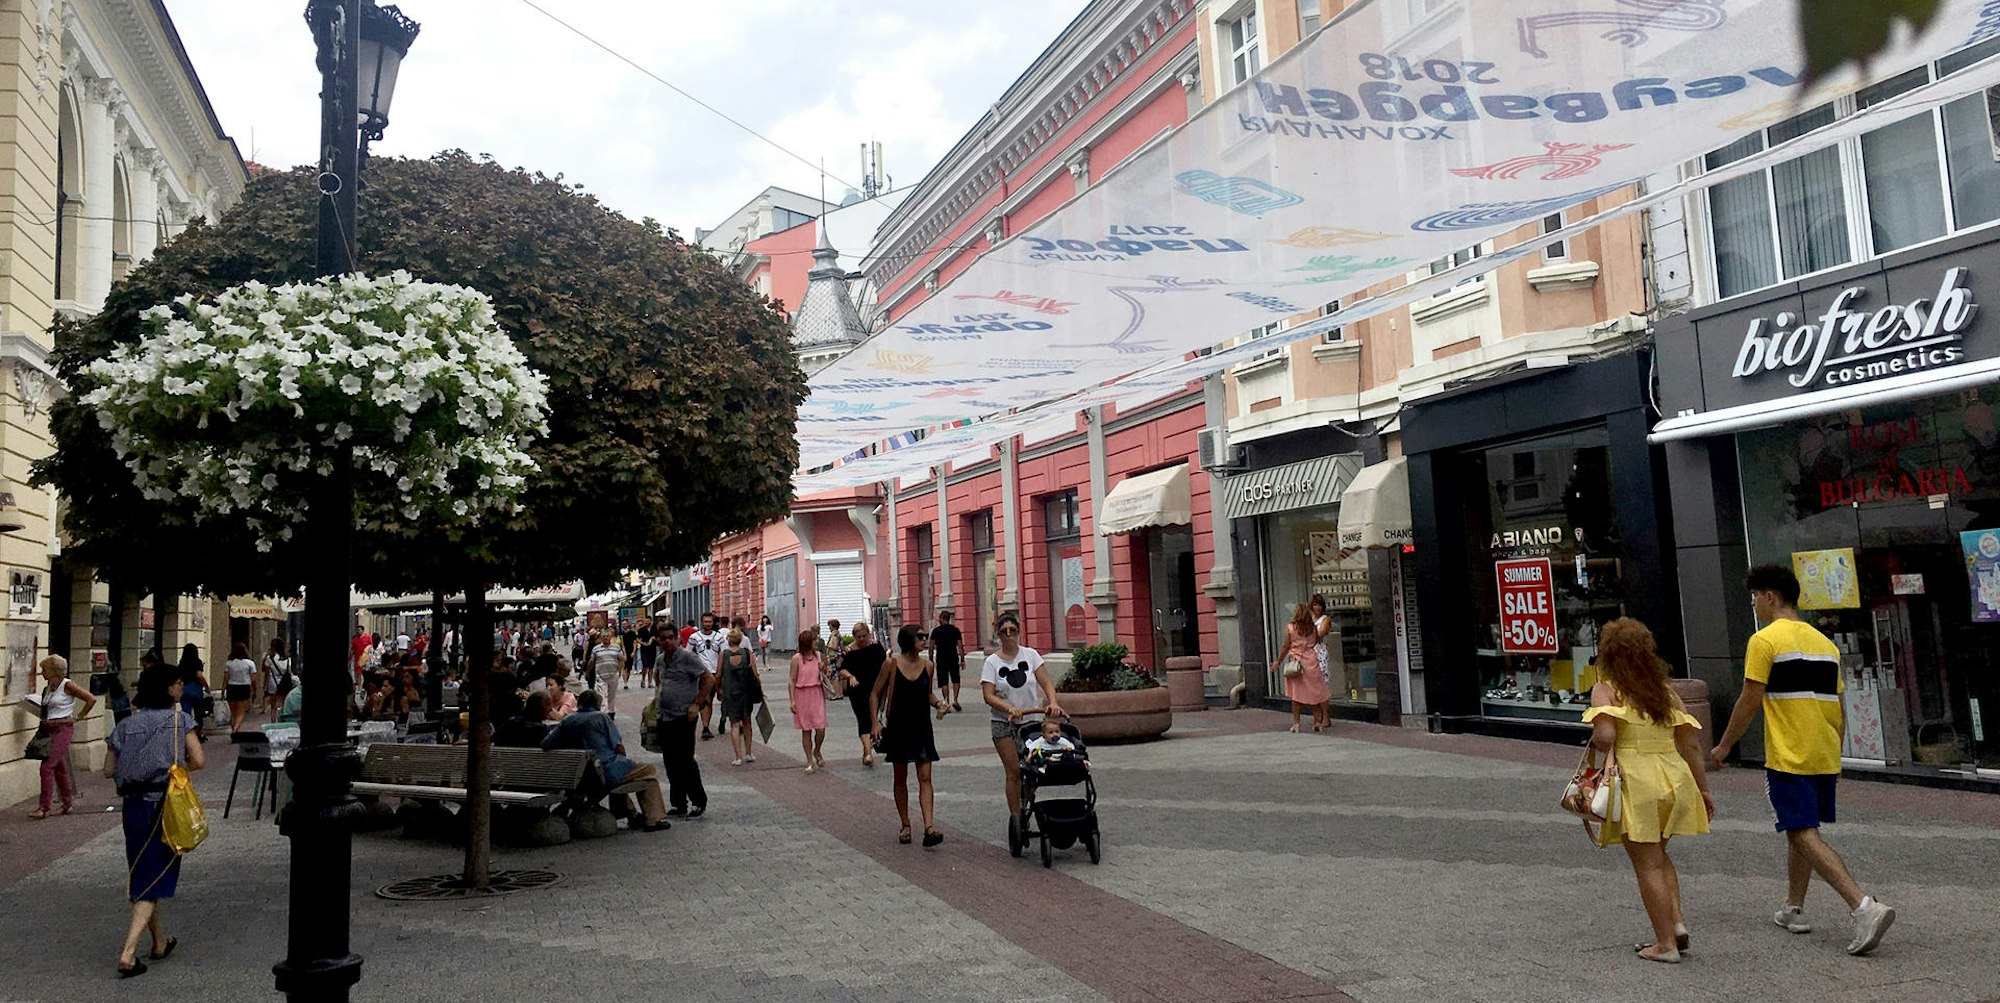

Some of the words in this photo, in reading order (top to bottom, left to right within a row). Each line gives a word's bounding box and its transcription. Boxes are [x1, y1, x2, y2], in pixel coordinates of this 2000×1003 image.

[1359, 52, 1500, 84] 2018
[1238, 112, 1454, 141] ХОЛАНДИЯ
[1109, 224, 1193, 237] 2017
[1020, 235, 1250, 257] Пафос
[893, 320, 1054, 335] Орхус
[952, 312, 1016, 324] 2017
[1732, 267, 1978, 387] biofresh
[1825, 346, 1959, 384] cosmetics
[1275, 479, 1313, 497] PARTNER
[1819, 465, 1974, 507] BULGARIA
[1342, 532, 1362, 543] CHANGE
[1504, 566, 1543, 583] SUMMER
[1391, 558, 1402, 637] CHANGE
[1505, 592, 1549, 616] SALE
